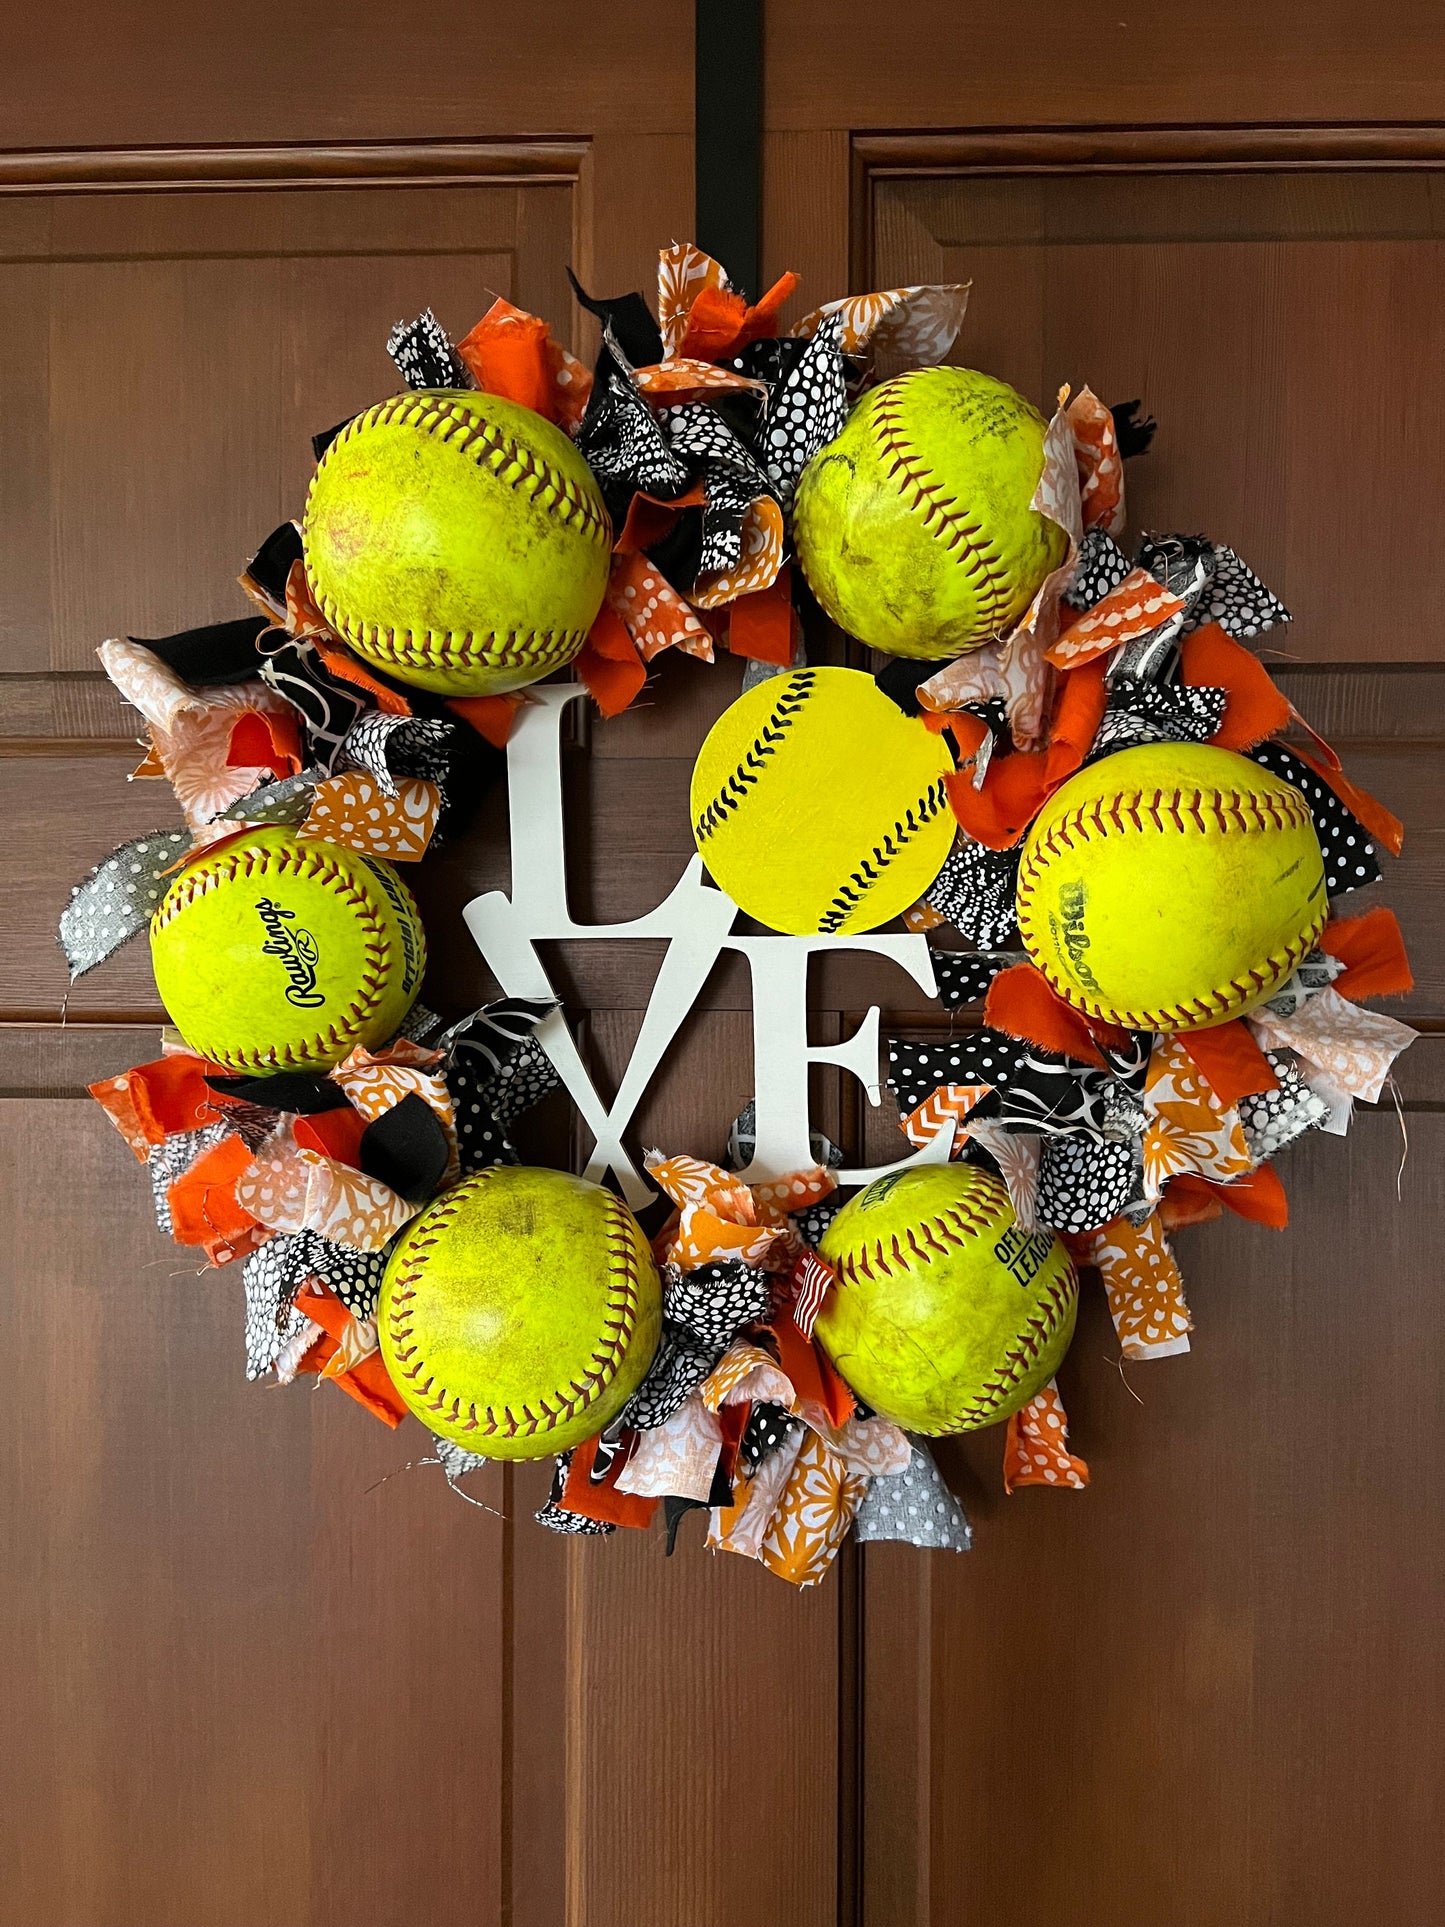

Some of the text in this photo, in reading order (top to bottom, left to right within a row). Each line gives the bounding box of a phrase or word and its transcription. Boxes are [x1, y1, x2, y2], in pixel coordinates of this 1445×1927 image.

[254, 896, 326, 1009] Rawlings
[1059, 878, 1104, 996] Wilson
[994, 1222, 1027, 1264] OFFI
